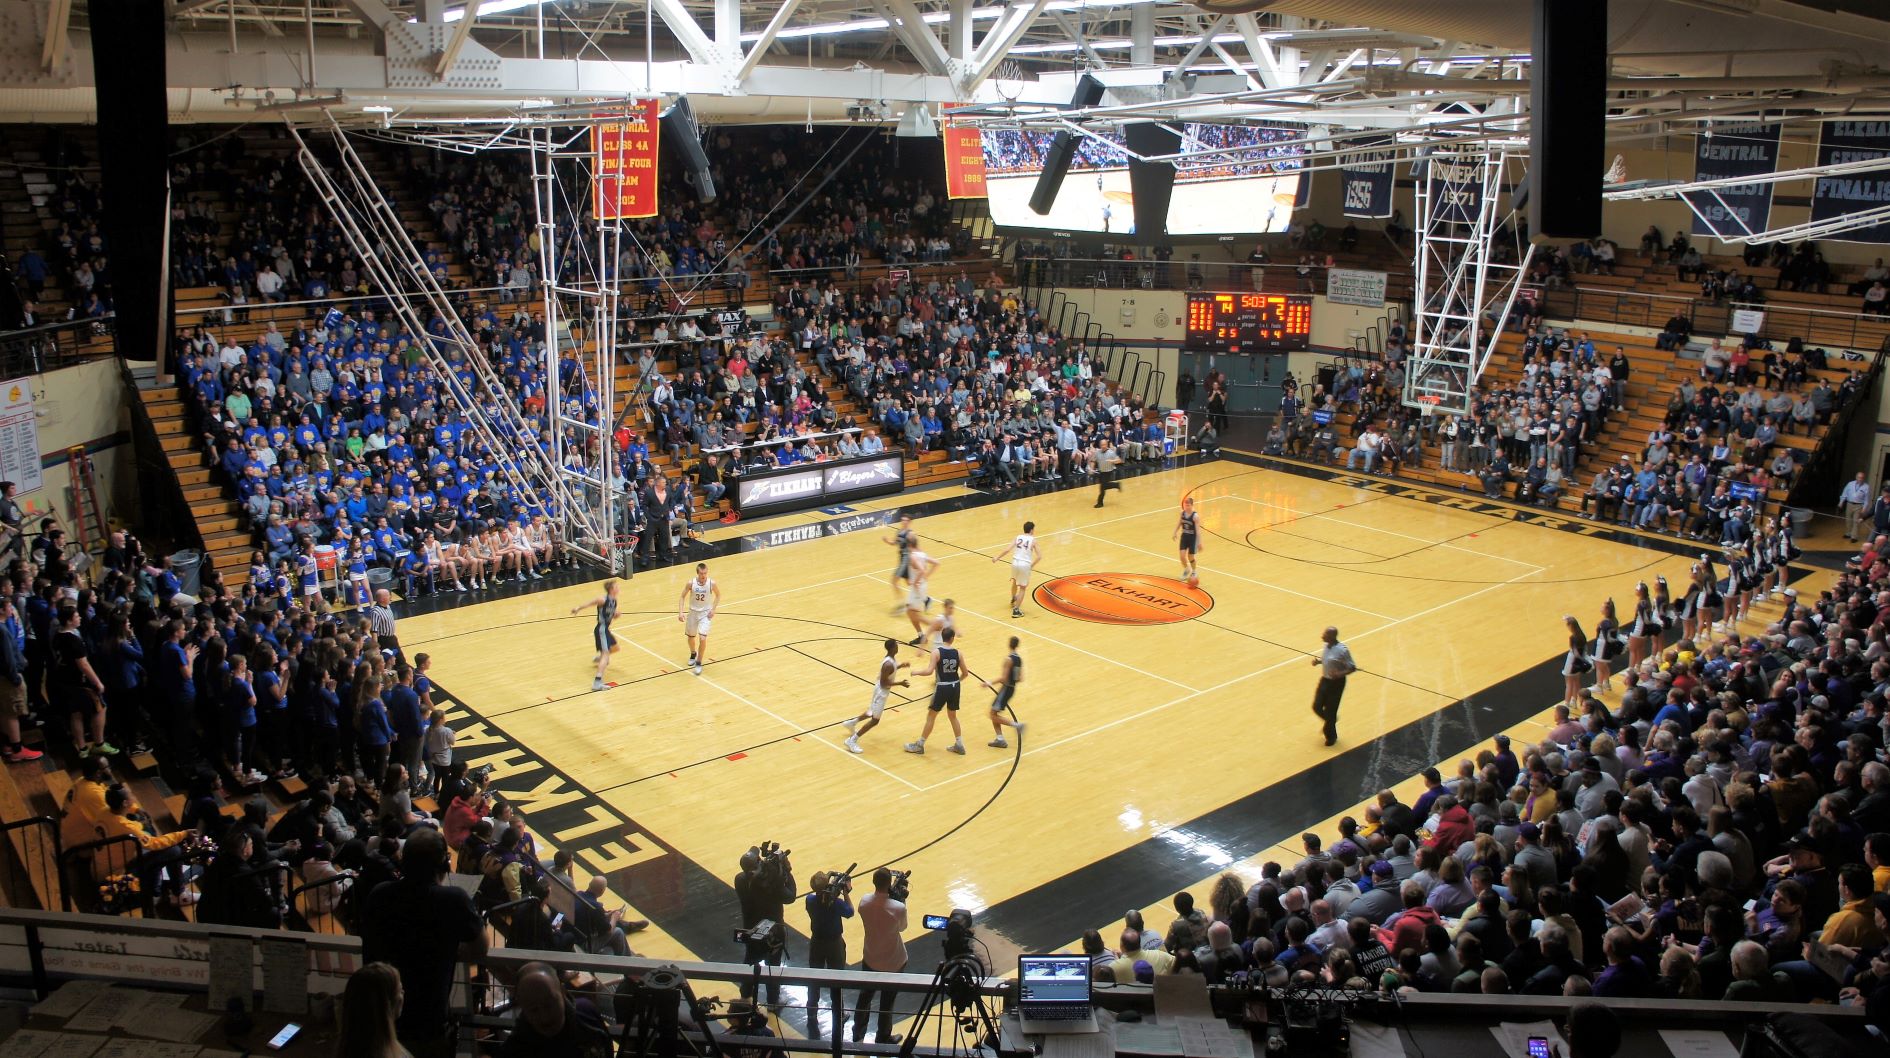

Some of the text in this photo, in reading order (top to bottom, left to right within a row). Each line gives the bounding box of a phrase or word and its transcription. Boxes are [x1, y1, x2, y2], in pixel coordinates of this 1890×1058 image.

[1834, 121, 1890, 136] ELKHA
[636, 141, 648, 150] 4A
[1700, 144, 1768, 160] CENTRAL
[630, 158, 651, 168] FOUR
[961, 156, 983, 164] EIGHT
[616, 195, 635, 205] 012
[1443, 190, 1475, 205] 1971
[1222, 302, 1233, 313] 14
[1241, 296, 1265, 308] 5:03
[1276, 304, 1284, 316] 2
[1218, 328, 1226, 337] 2
[1230, 328, 1237, 337] 5
[1261, 330, 1268, 338] 4
[1274, 330, 1281, 338] 4
[769, 476, 823, 497] ELKHART
[1334, 475, 1615, 536] ELKHART
[1016, 538, 1029, 550] 24
[695, 593, 706, 602] 32
[1087, 579, 1188, 609] ELKHART
[942, 658, 957, 673] 22
[431, 683, 669, 875] ELKHA
